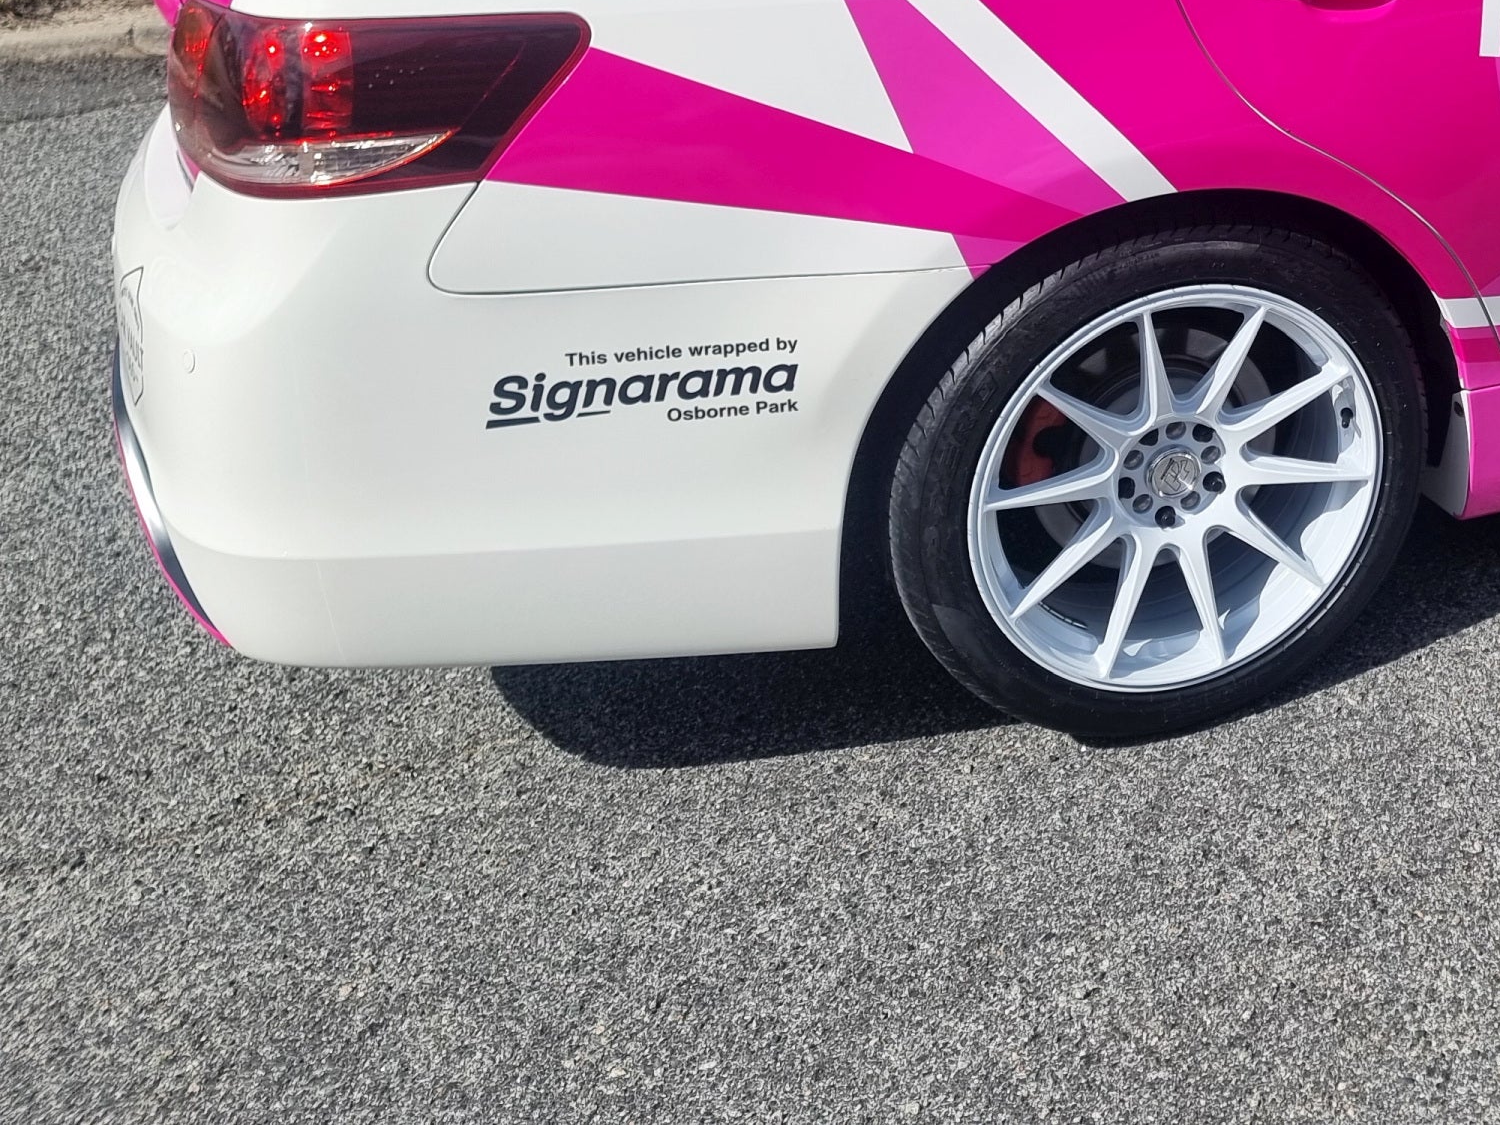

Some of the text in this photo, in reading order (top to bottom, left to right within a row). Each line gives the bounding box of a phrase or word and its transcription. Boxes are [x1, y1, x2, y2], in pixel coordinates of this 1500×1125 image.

[565, 337, 798, 367] This vehicle wrapped by
[486, 363, 799, 425] Signarama
[666, 398, 799, 422] Osborne Park
